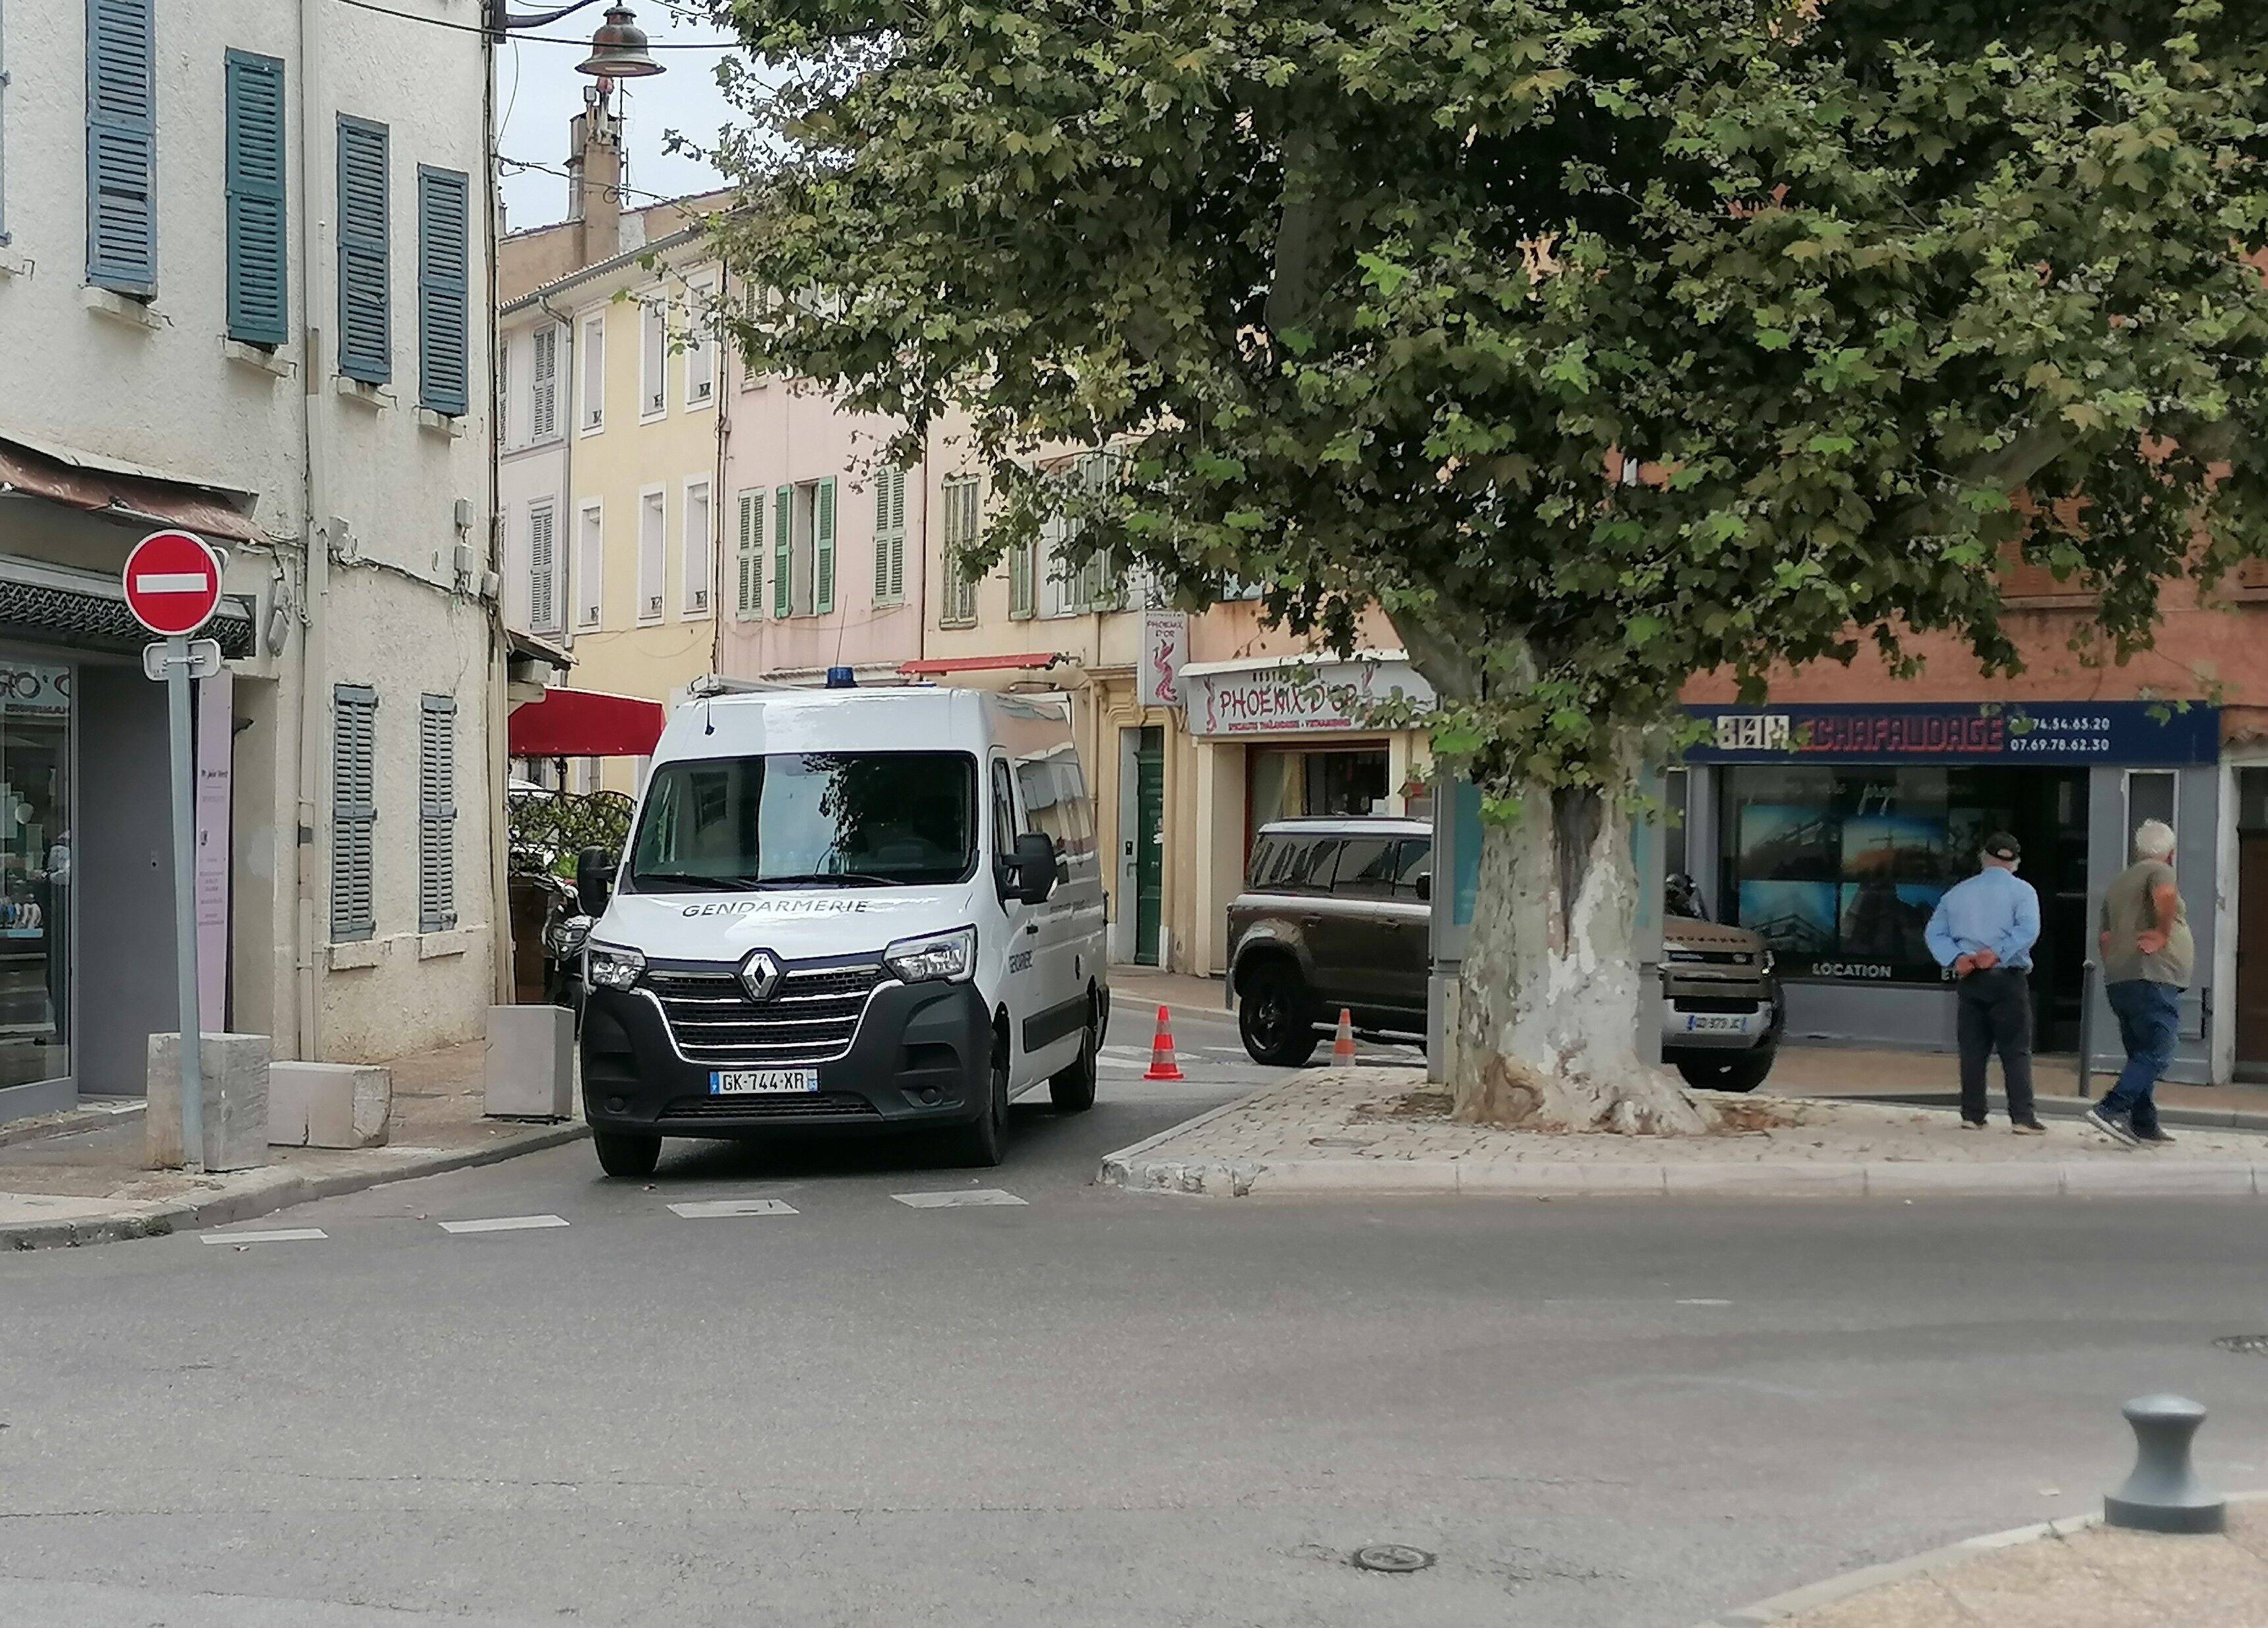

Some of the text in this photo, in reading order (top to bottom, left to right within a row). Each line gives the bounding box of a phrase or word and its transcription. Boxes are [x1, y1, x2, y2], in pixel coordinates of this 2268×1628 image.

[1219, 682, 1305, 719] PHOENIX
[2010, 738, 2110, 751] 07.69.78.62.30
[682, 899, 869, 917] GENDARMERIE
[1812, 962, 1891, 978] LOCATION
